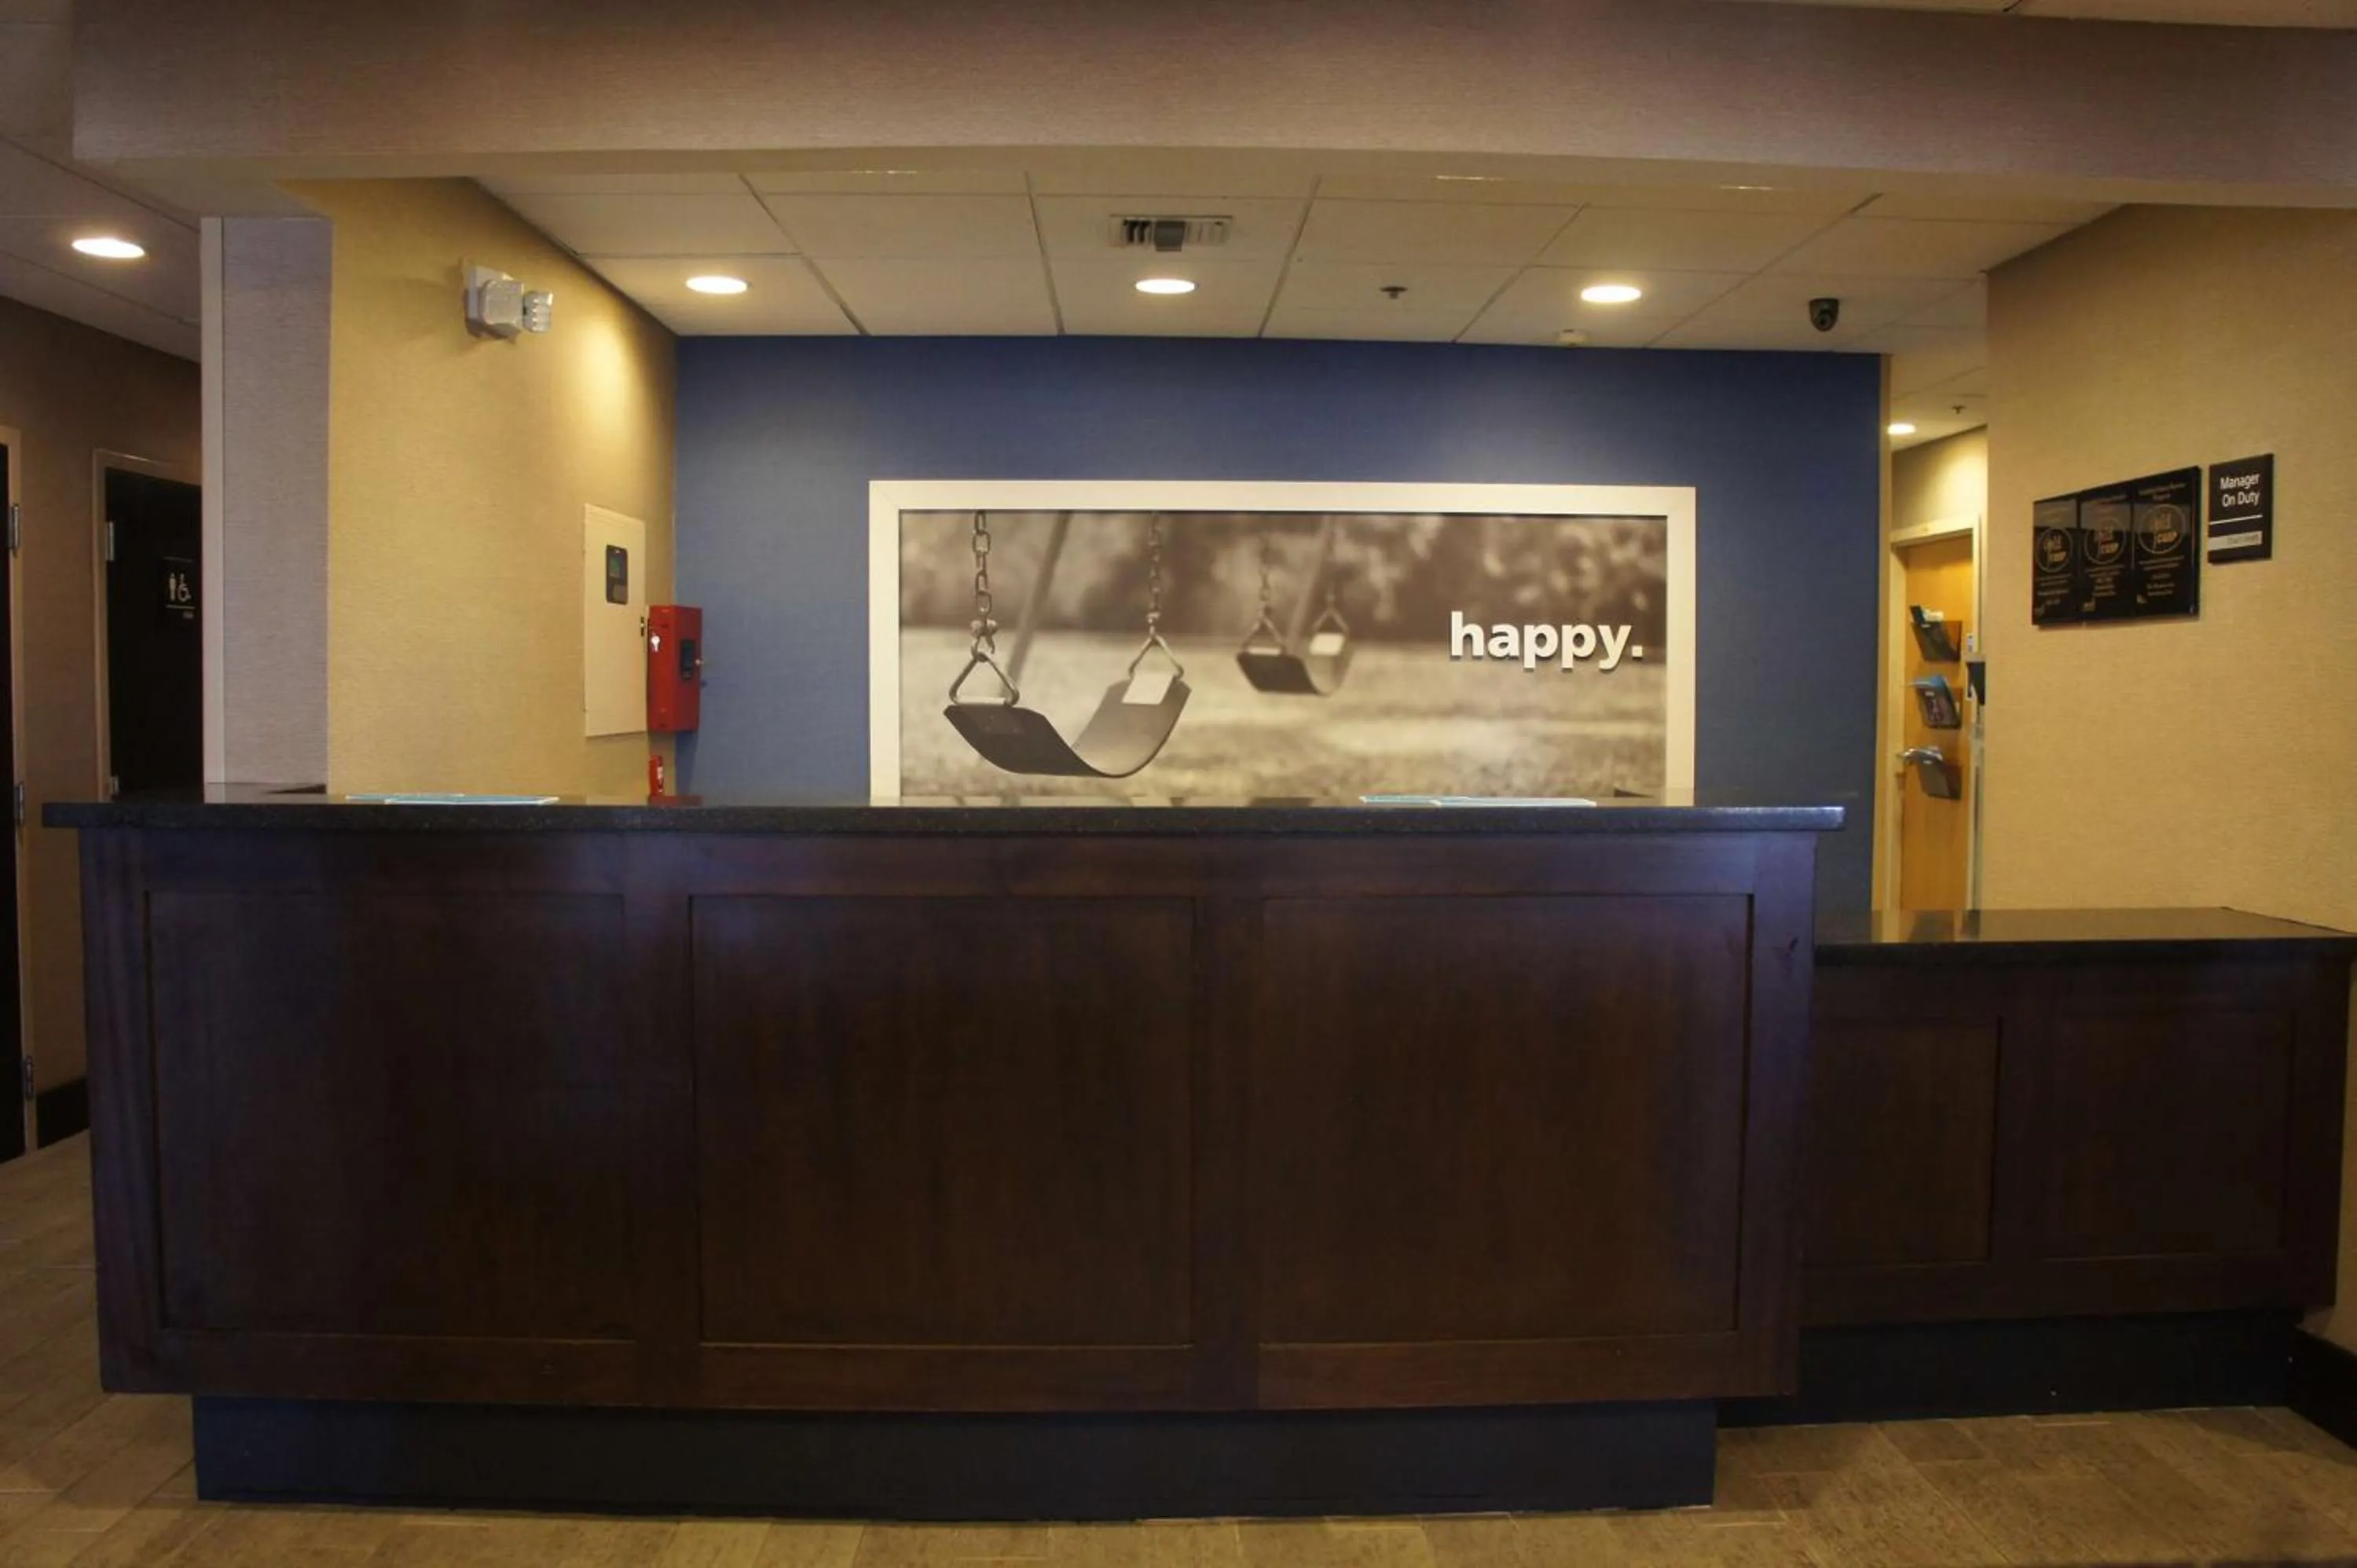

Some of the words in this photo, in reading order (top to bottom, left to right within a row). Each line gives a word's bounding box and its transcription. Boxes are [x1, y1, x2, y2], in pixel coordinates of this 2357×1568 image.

[2220, 474, 2260, 489] Manager
[2222, 494, 2235, 507] On
[2238, 492, 2260, 506] Duty
[1451, 610, 1643, 670] happy.
